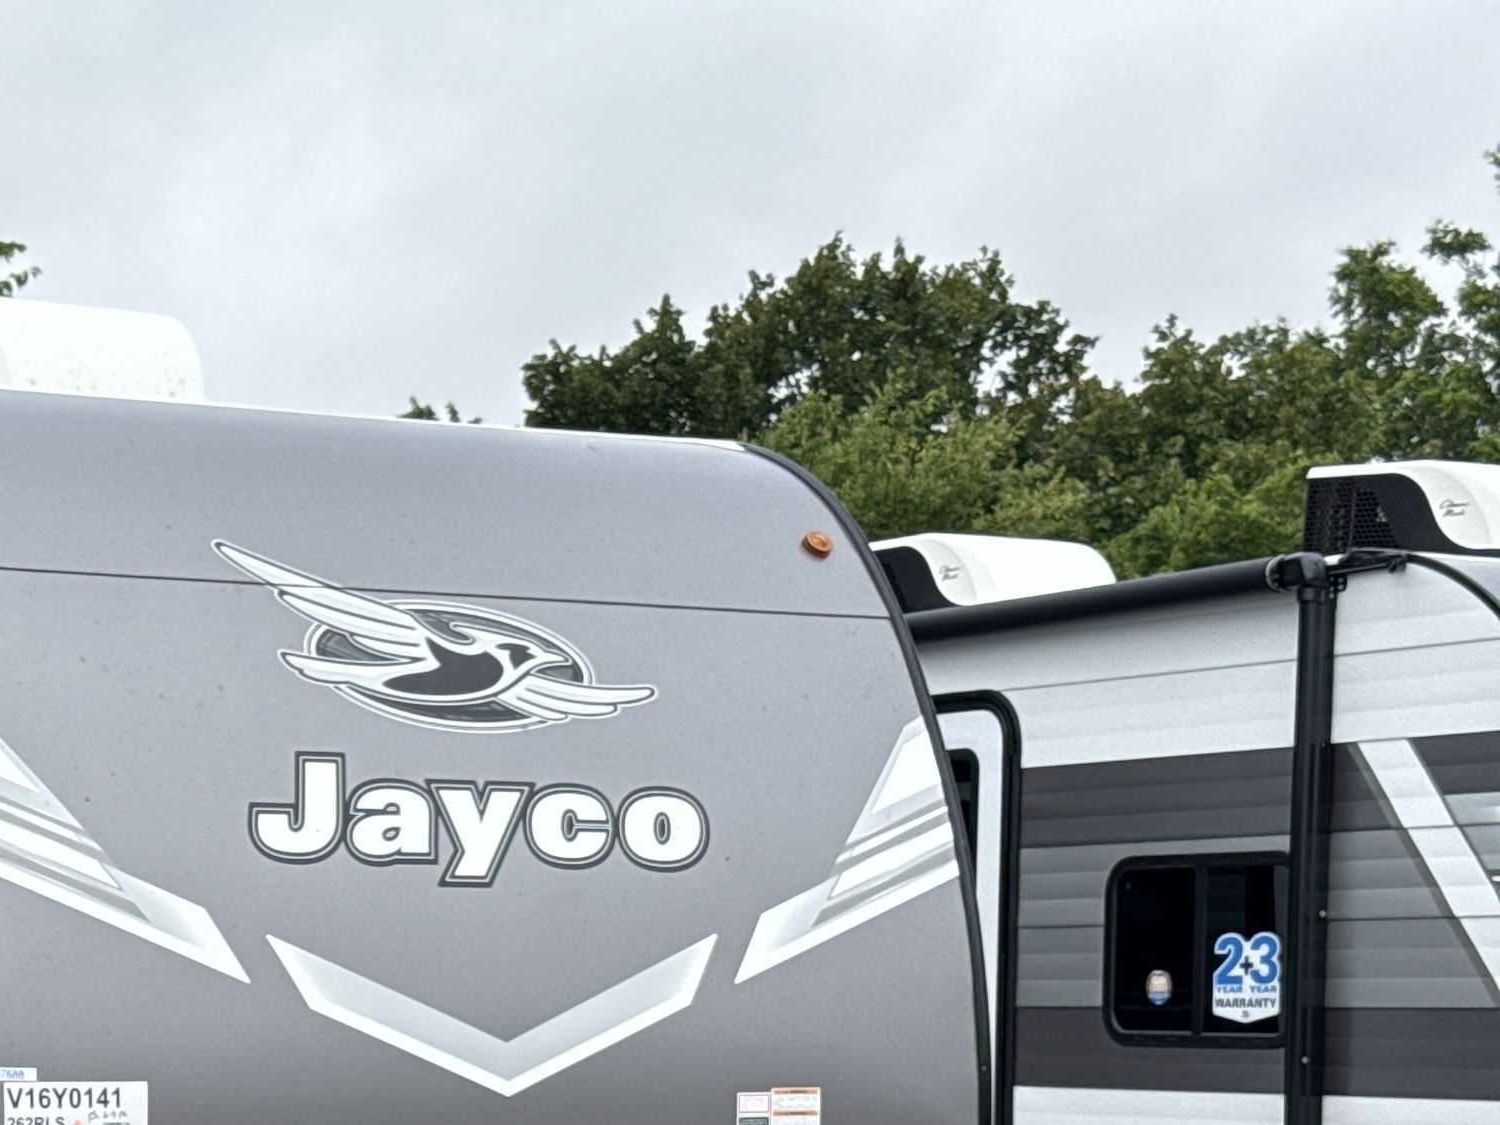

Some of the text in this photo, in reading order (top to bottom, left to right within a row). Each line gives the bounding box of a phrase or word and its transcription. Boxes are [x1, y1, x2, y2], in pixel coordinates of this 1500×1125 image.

[248, 750, 710, 888] Jayco
[1216, 985, 1277, 993] YEAR YEAR
[1215, 997, 1277, 1008] WARRANTY
[7, 1087, 121, 1109] V16Y0141
